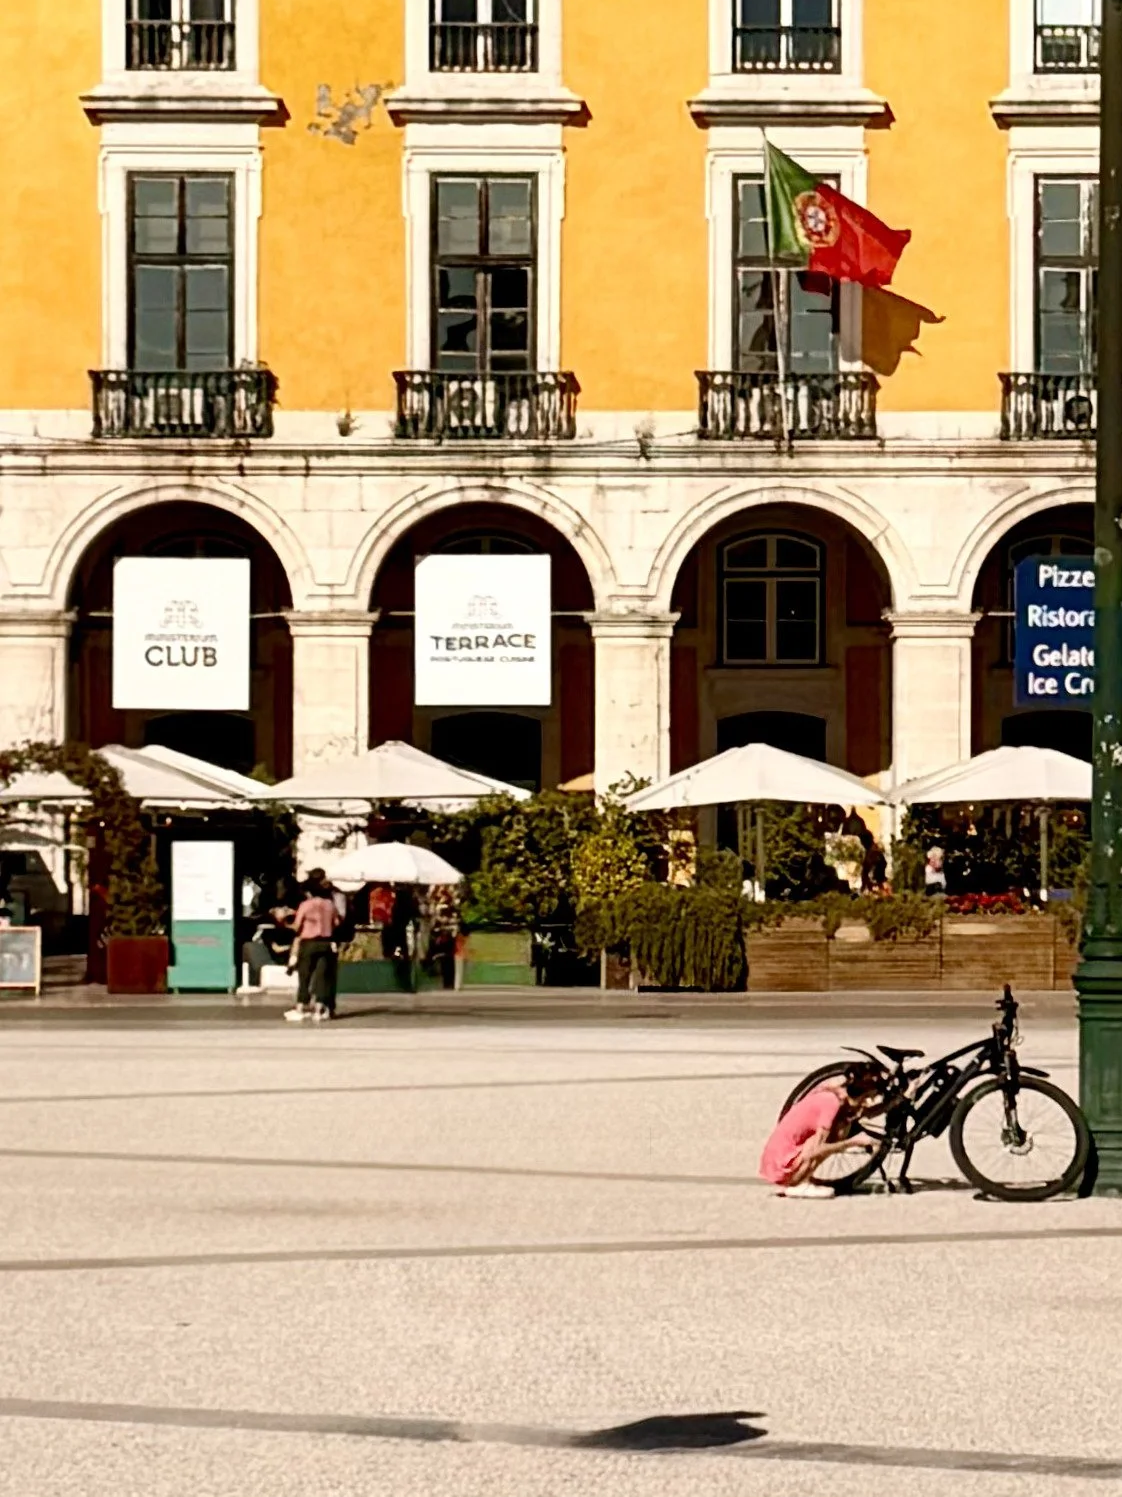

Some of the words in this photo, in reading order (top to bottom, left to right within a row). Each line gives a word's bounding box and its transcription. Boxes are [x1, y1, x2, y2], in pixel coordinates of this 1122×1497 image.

[429, 633, 537, 651] TERRACE
[144, 645, 218, 667] CLUB
[1027, 672, 1059, 695] Ice
